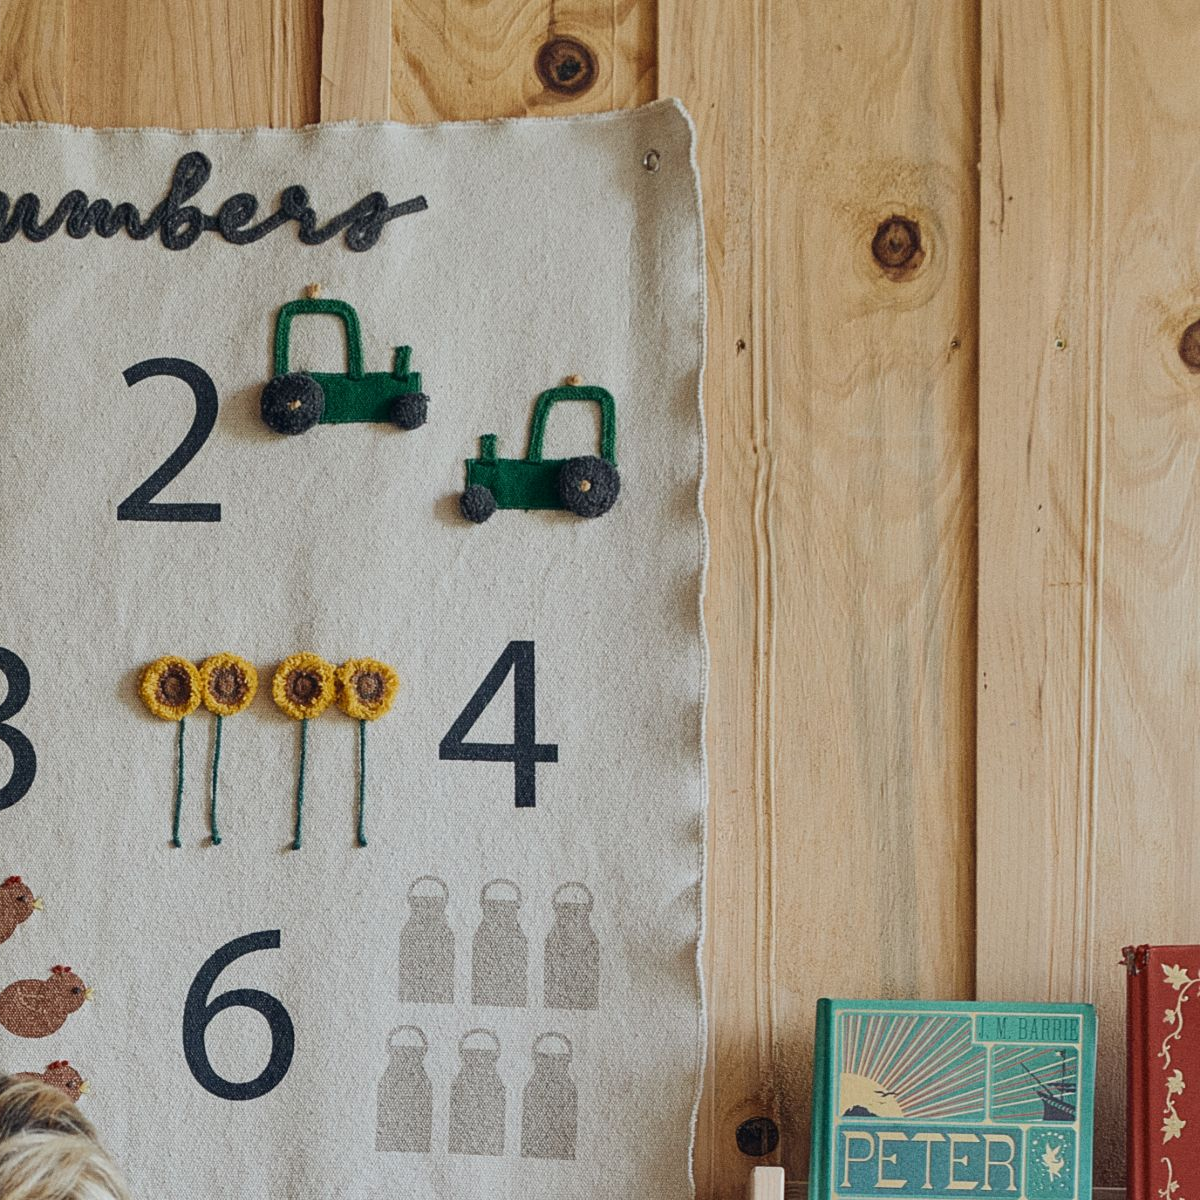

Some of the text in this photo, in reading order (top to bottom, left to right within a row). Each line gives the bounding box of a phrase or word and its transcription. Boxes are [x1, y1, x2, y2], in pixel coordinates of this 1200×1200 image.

[117, 358, 221, 522] 2
[439, 641, 558, 808] 4
[183, 929, 295, 1100] 6
[1017, 1017, 1079, 1041] BARRIE
[840, 1131, 1017, 1191] PETER
